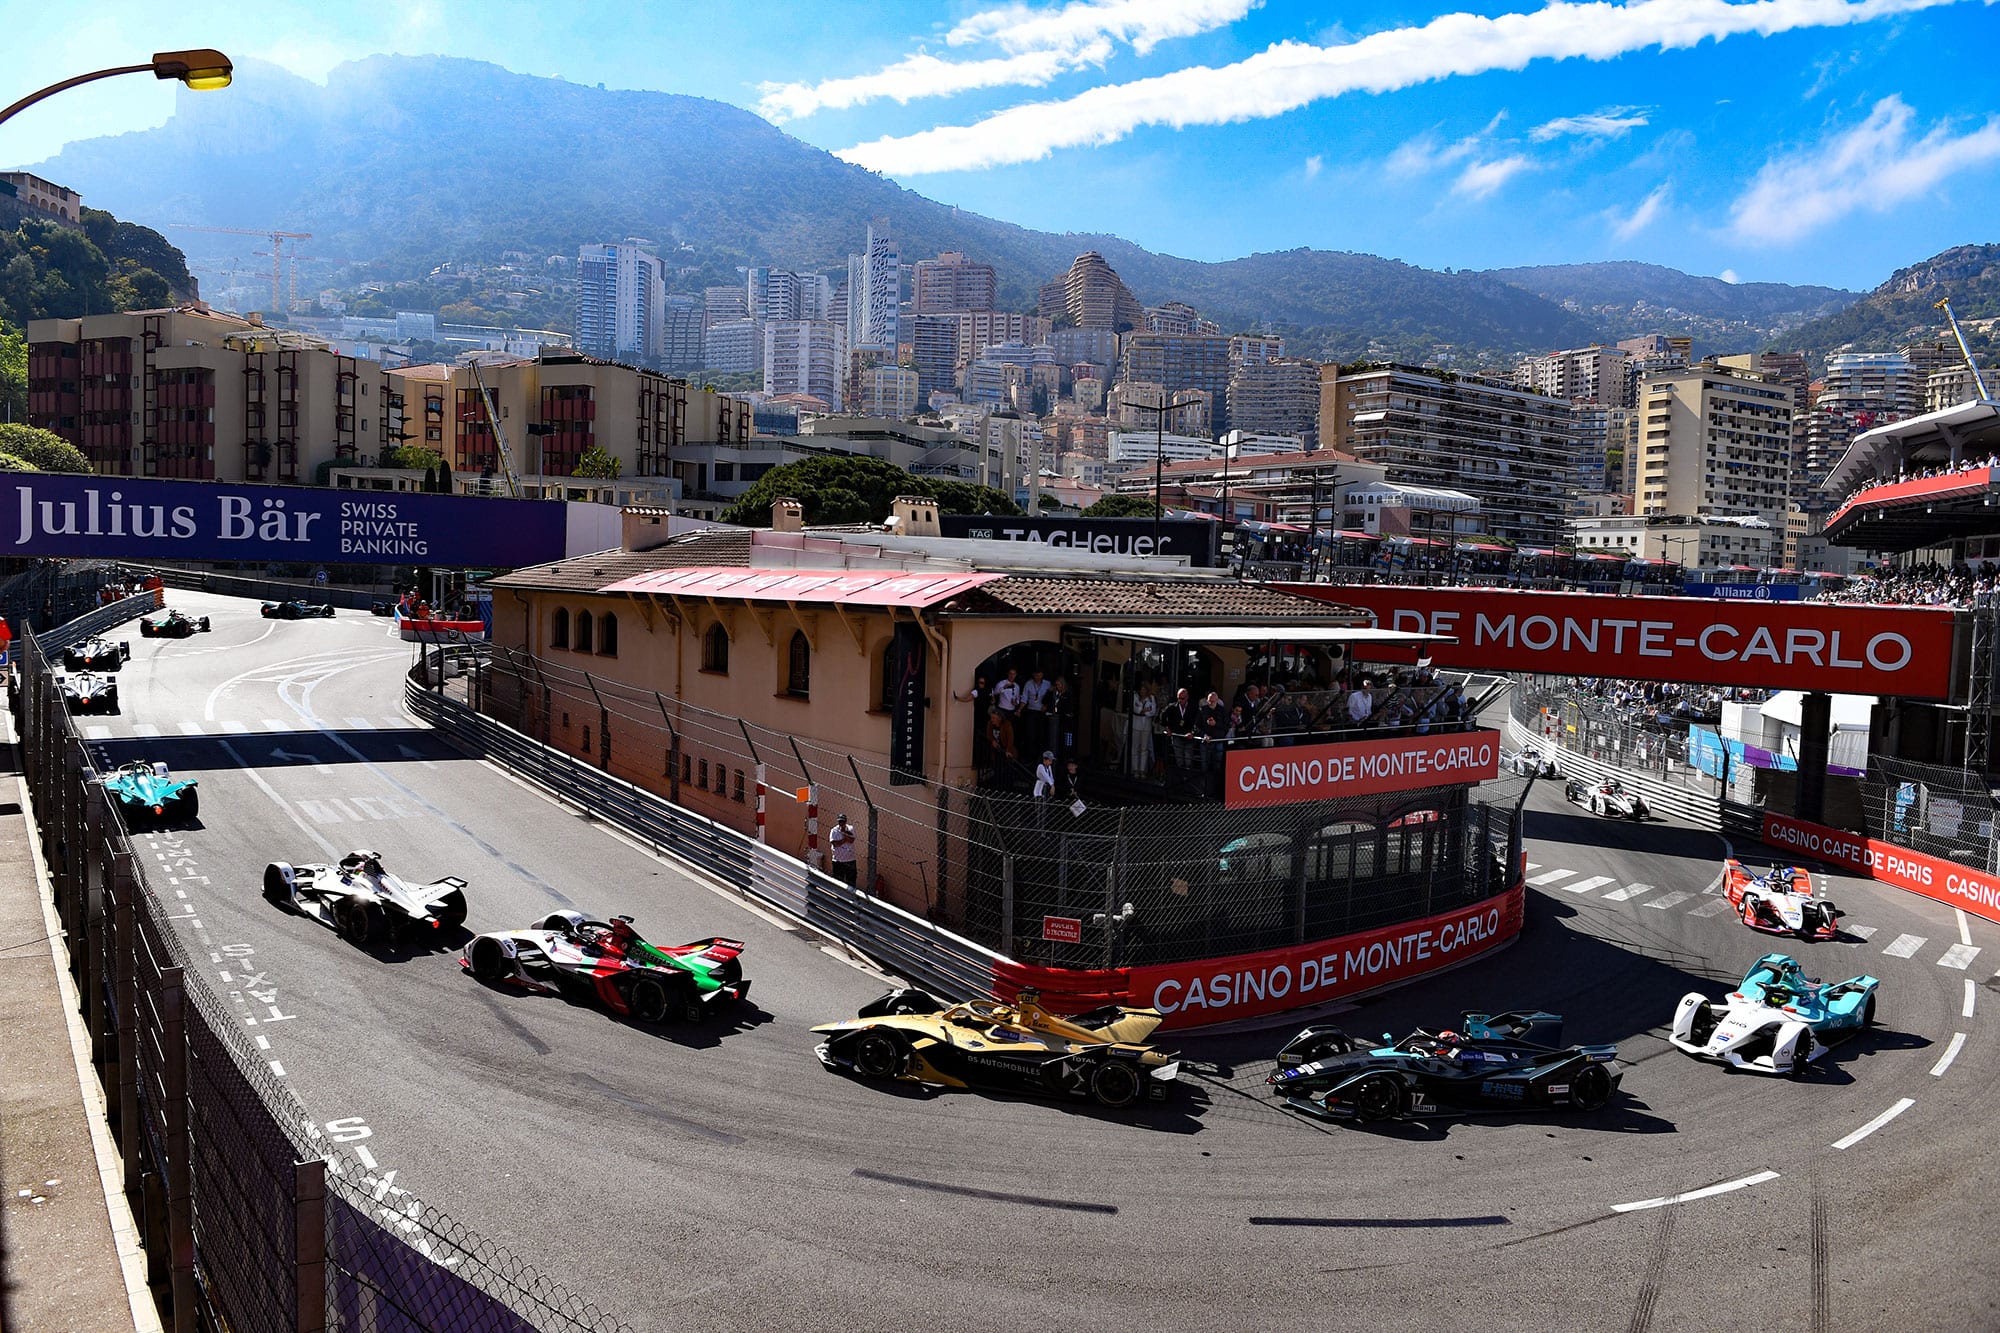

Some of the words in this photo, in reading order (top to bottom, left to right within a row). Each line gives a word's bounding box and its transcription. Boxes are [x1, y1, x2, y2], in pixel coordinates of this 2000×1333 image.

[16, 486, 197, 544] Julius
[217, 496, 321, 542] Bär
[341, 502, 397, 519] SWISS
[341, 520, 418, 537] PRIVATE
[341, 538, 428, 555] BANKING
[1713, 587, 1753, 598] Allianz
[1476, 612, 1912, 671] MONTE-CARLO
[1239, 758, 1322, 792] CASINO
[1328, 756, 1355, 783] DE
[1359, 744, 1491, 780] MONTE-CARLO
[1770, 822, 1820, 852] CASINO
[1823, 838, 1861, 863] CAFE
[1863, 848, 1885, 871] DE
[1887, 856, 1933, 886] PARIS
[630, 946, 675, 967] SCHAEFFLER
[1154, 965, 1291, 1014] CASINO
[1300, 954, 1337, 993] DE
[1344, 908, 1499, 980] MONTE-CARLO
[222, 943, 297, 1023] TAXIS
[1728, 1020, 1747, 1028] NIO
[1829, 1019, 1843, 1028] NIO
[968, 1056, 979, 1064] DS
[980, 1058, 1041, 1076] AUTOMOBILES
[1072, 1056, 1097, 1064] TOTAL
[1411, 1093, 1425, 1105] 17
[1413, 1105, 1437, 1113] MAHLE
